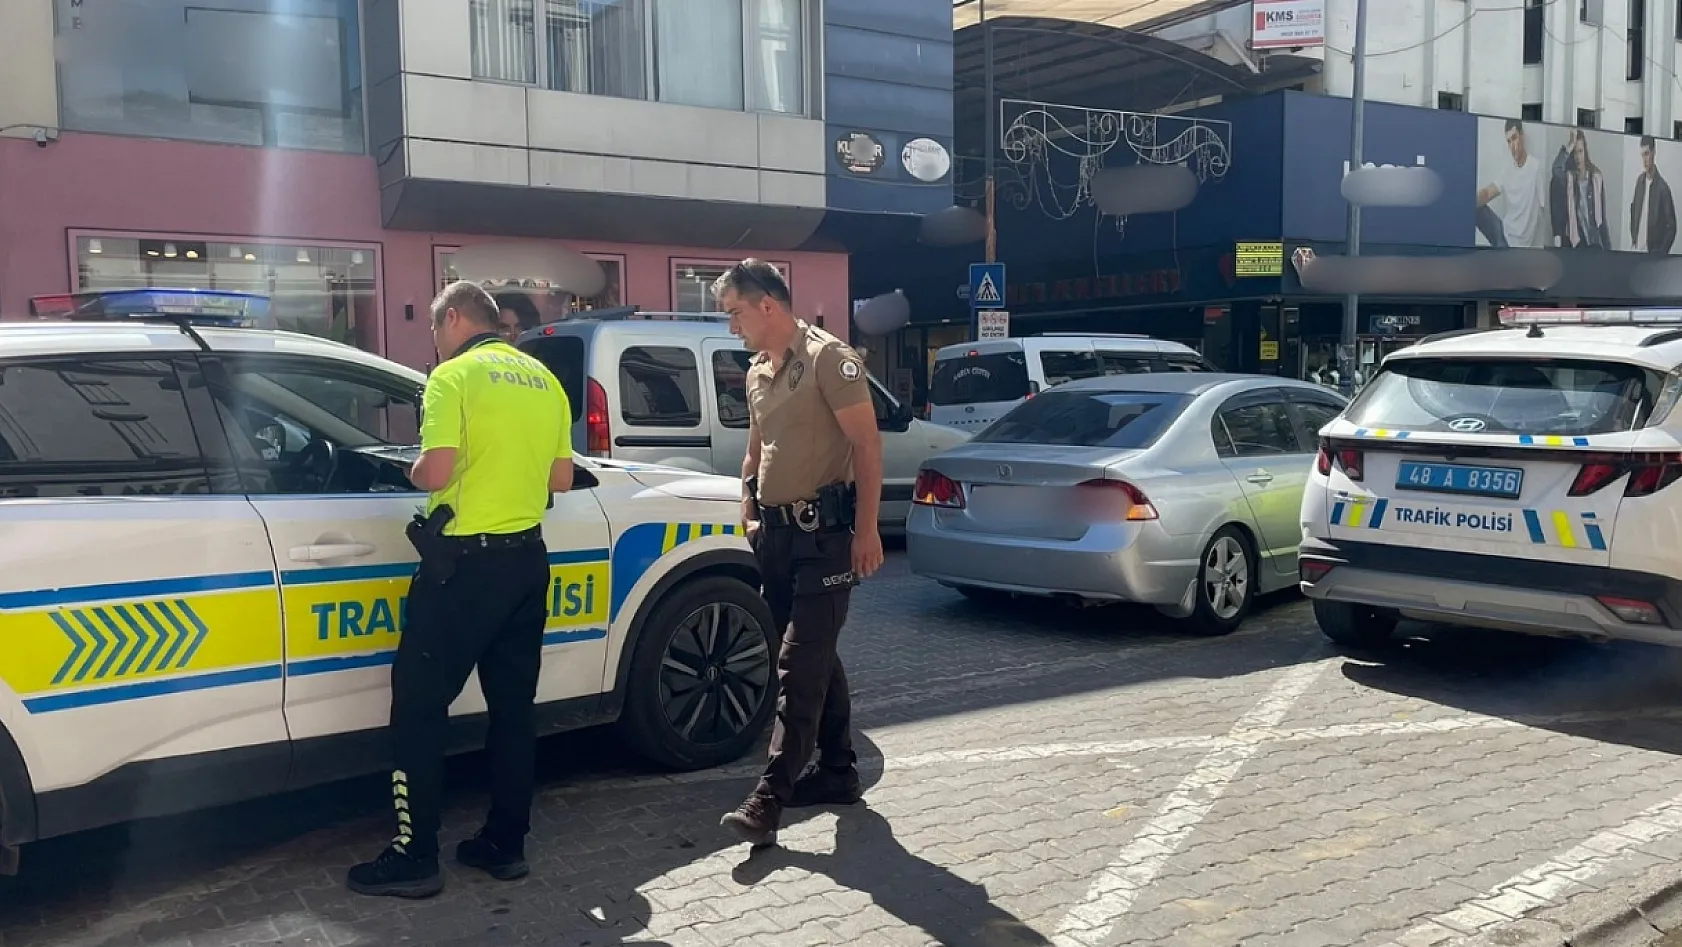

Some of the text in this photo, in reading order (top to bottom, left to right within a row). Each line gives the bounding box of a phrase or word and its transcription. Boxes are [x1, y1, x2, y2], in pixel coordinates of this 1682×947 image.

[1266, 10, 1294, 22] KMS
[1409, 466, 1517, 492] 48 A 8356
[1395, 506, 1513, 532] TRAFİK POLİSİ
[311, 596, 410, 640] TRA
